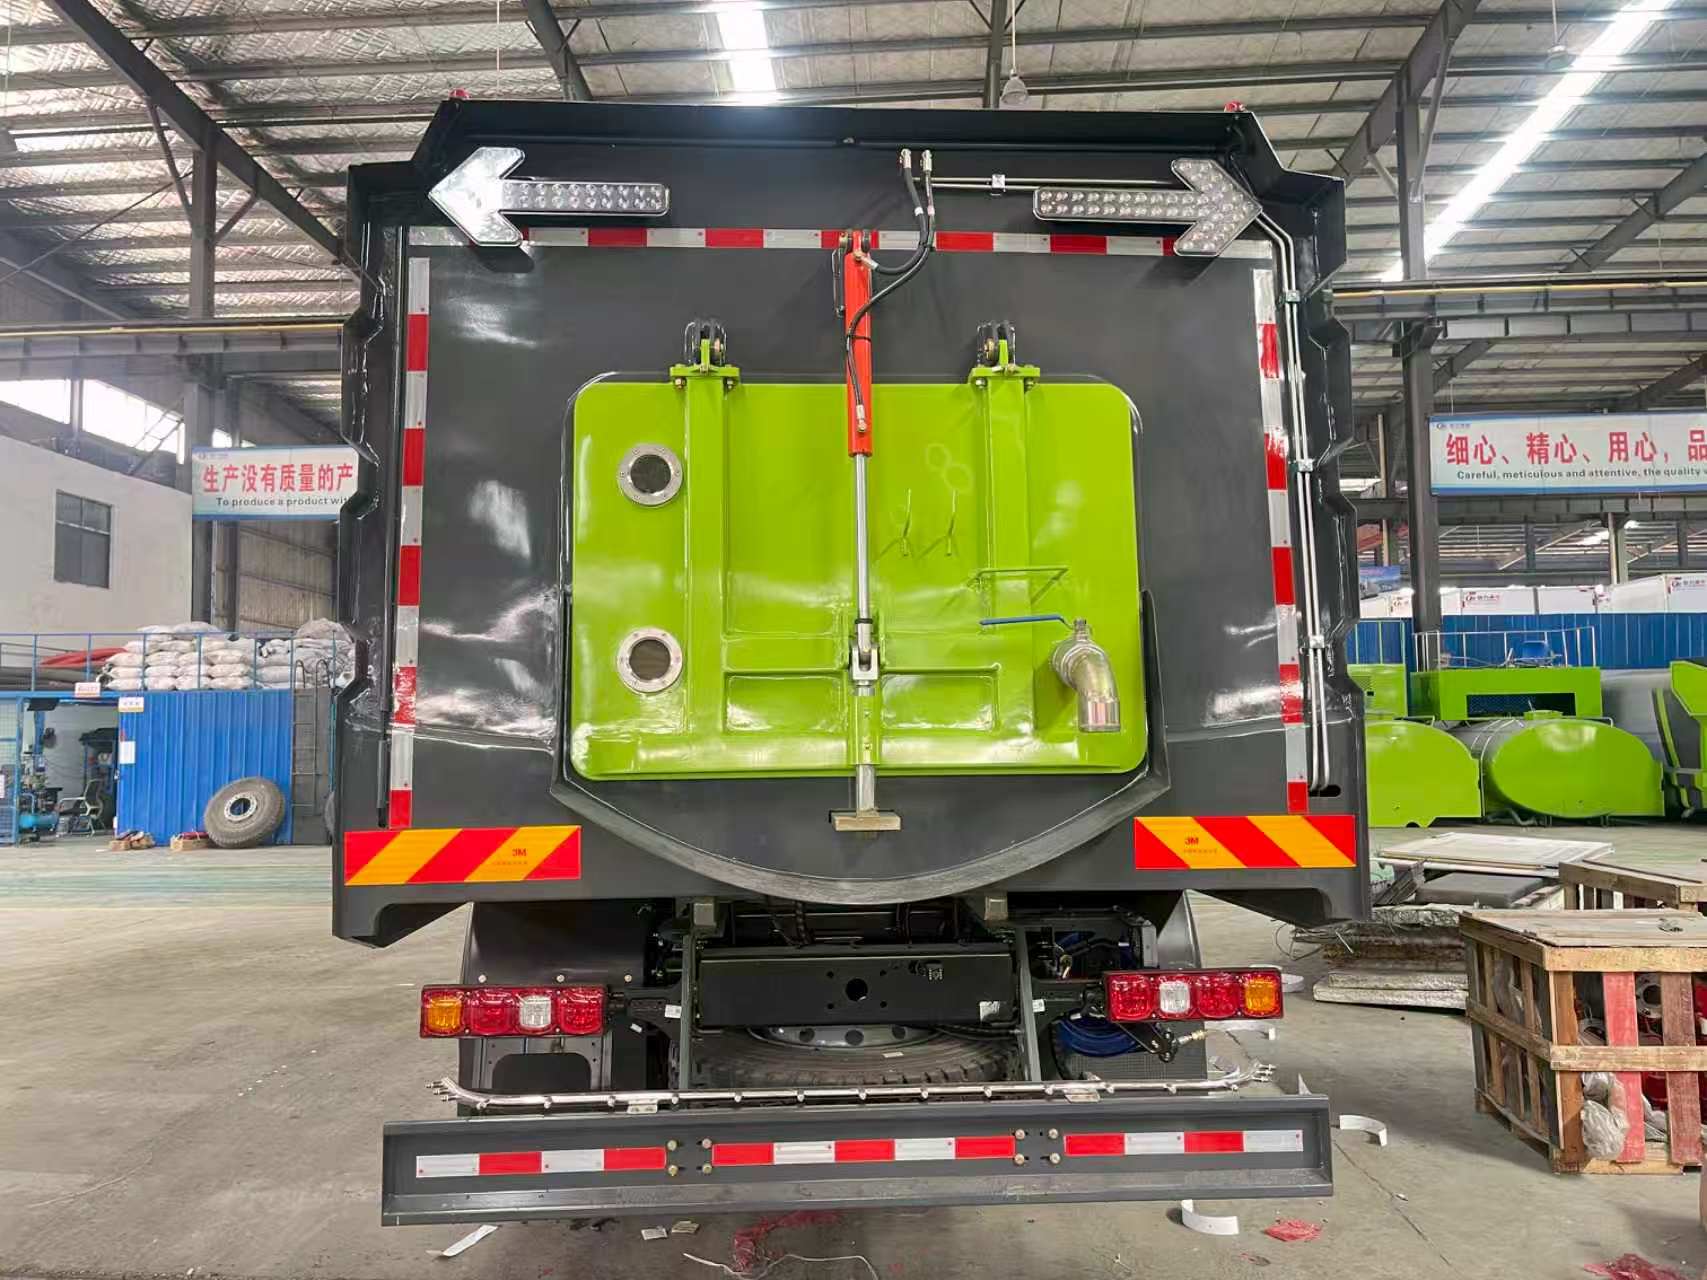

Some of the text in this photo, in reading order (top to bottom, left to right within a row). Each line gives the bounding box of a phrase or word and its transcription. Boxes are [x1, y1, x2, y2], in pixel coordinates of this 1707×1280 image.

[203, 463, 353, 493] 生产没有质量的产
[1457, 470, 1501, 480] Careful,
[1502, 469, 1563, 479] meticulous
[1566, 469, 1586, 478] and
[1589, 468, 1641, 478] attentive,
[1643, 466, 1661, 476] the
[1664, 466, 1700, 478] quality
[216, 497, 229, 506] To
[232, 497, 275, 507] produce
[286, 496, 328, 507] product
